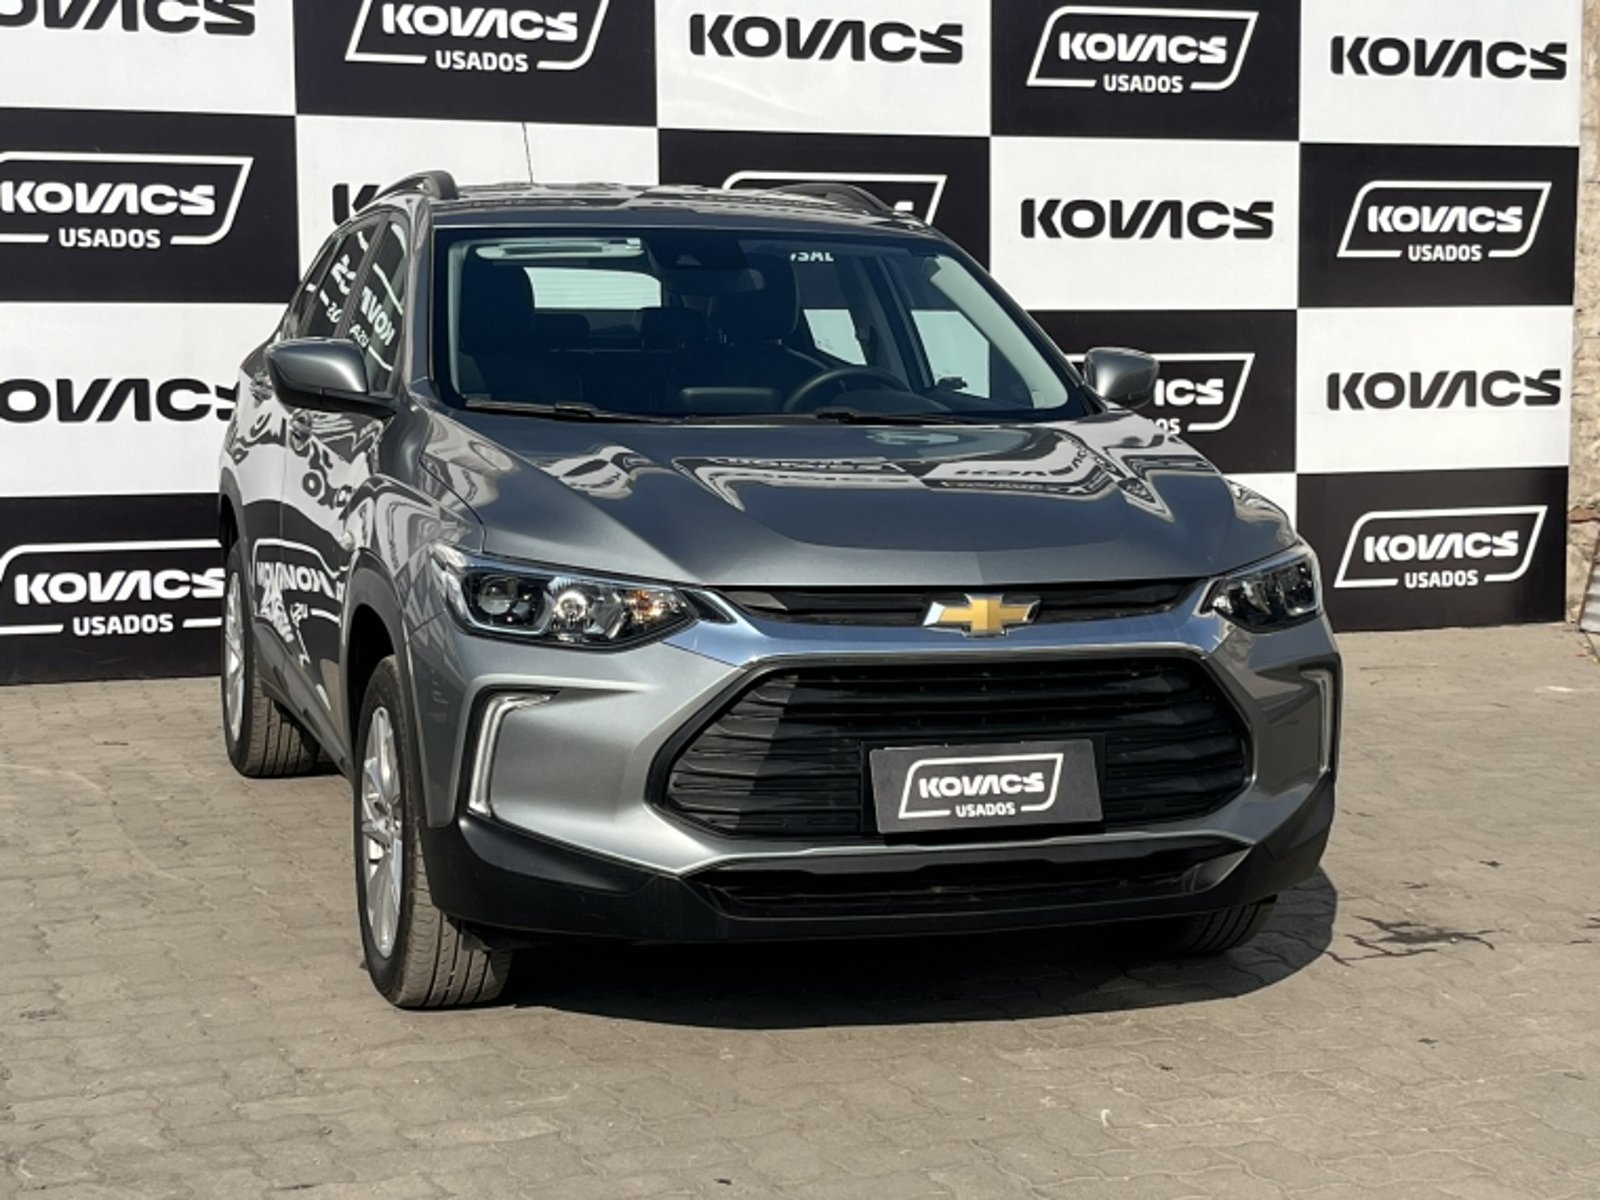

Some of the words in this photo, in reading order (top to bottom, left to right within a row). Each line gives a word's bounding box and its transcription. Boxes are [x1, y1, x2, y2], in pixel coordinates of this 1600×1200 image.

[383, 4, 577, 41] KOVACS
[690, 14, 962, 64] KOVACS
[1060, 32, 1226, 63] KOVACS
[436, 50, 528, 72] USADOS
[1331, 36, 1567, 80] KOVACS
[1104, 74, 1183, 93] USADOS
[0, 181, 214, 215] KOVACS
[1021, 199, 1273, 239] KOVACS
[1368, 206, 1522, 232] KOVACS
[59, 228, 160, 248] USADOS
[1408, 245, 1482, 261] USADOS
[1327, 369, 1561, 410] KOVACS
[1365, 531, 1518, 562] KOVACS
[15, 568, 225, 604] KOVACS
[1405, 570, 1478, 588] USADOS
[73, 614, 173, 636] USADOS
[919, 773, 1044, 798] KOVACS
[956, 802, 1015, 817] USADOS
